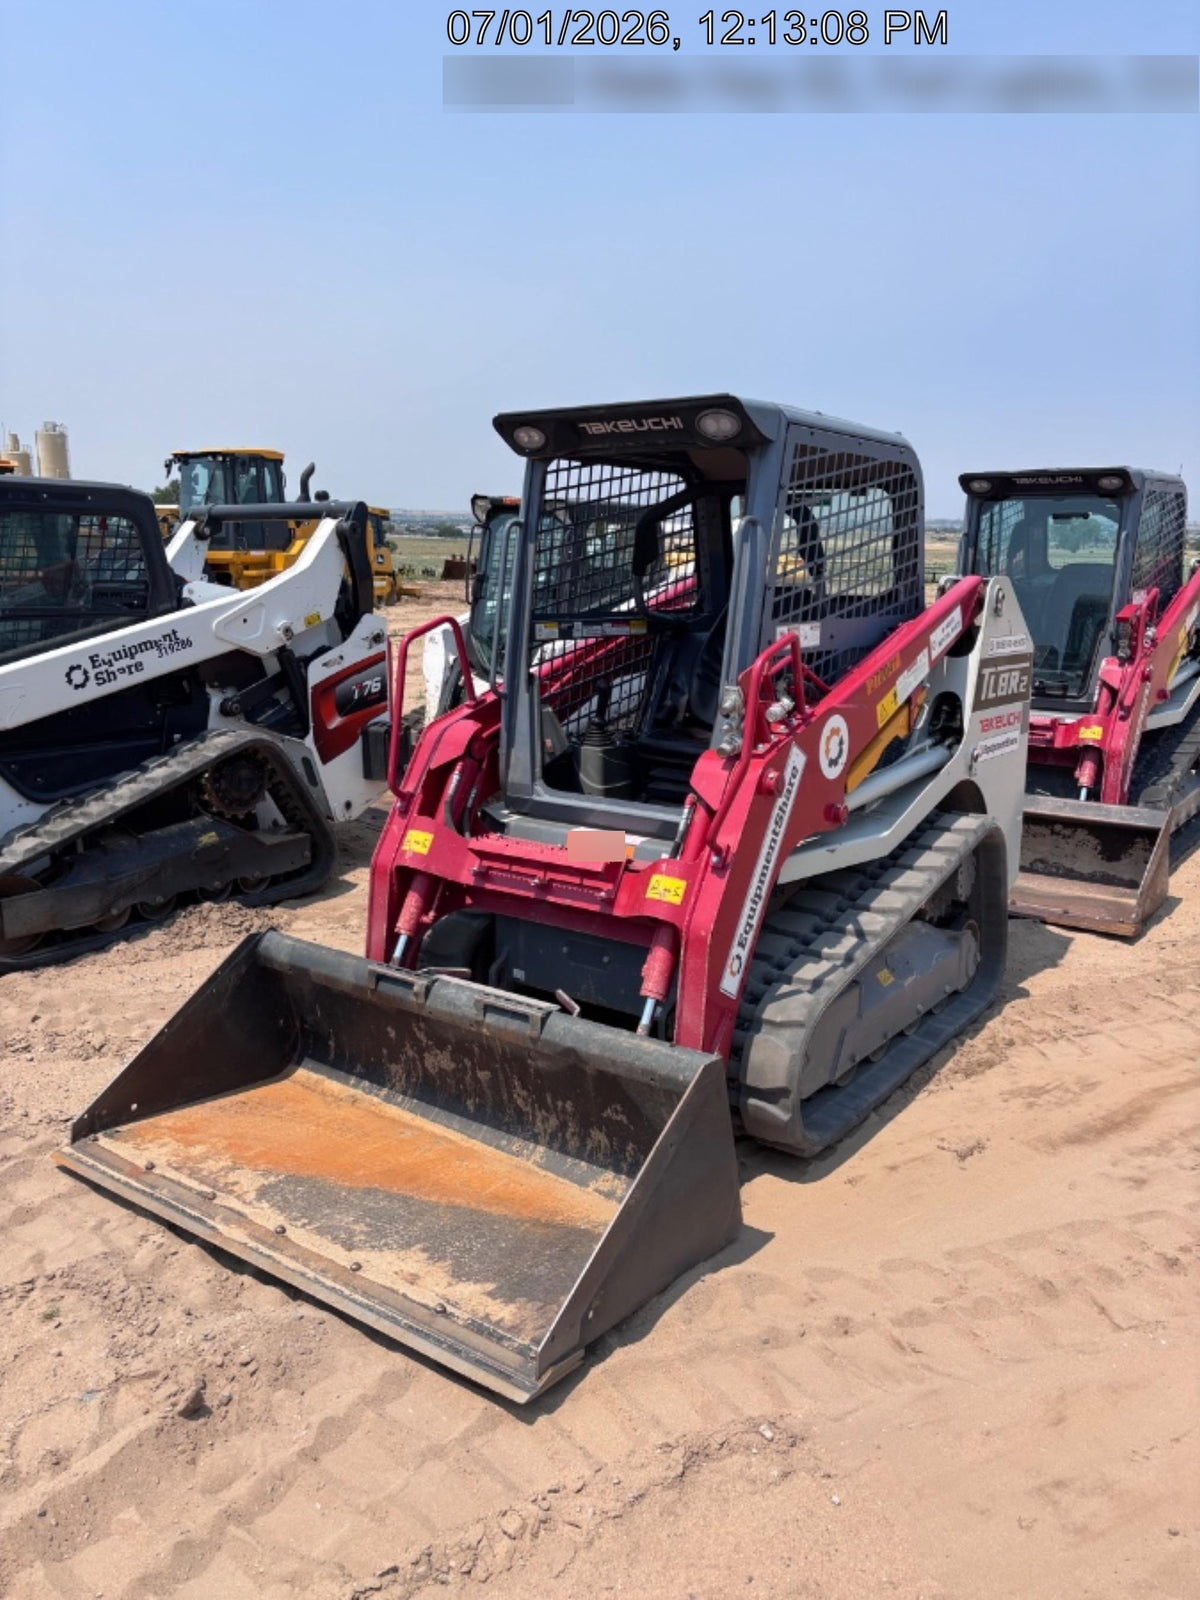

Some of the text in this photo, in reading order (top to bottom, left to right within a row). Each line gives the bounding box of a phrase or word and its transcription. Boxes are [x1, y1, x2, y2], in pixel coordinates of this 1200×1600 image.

[578, 416, 684, 434] TAKEUCHI
[88, 628, 180, 669] Equipment
[94, 660, 144, 687] Share
[736, 765, 799, 952] EquipmentShare
